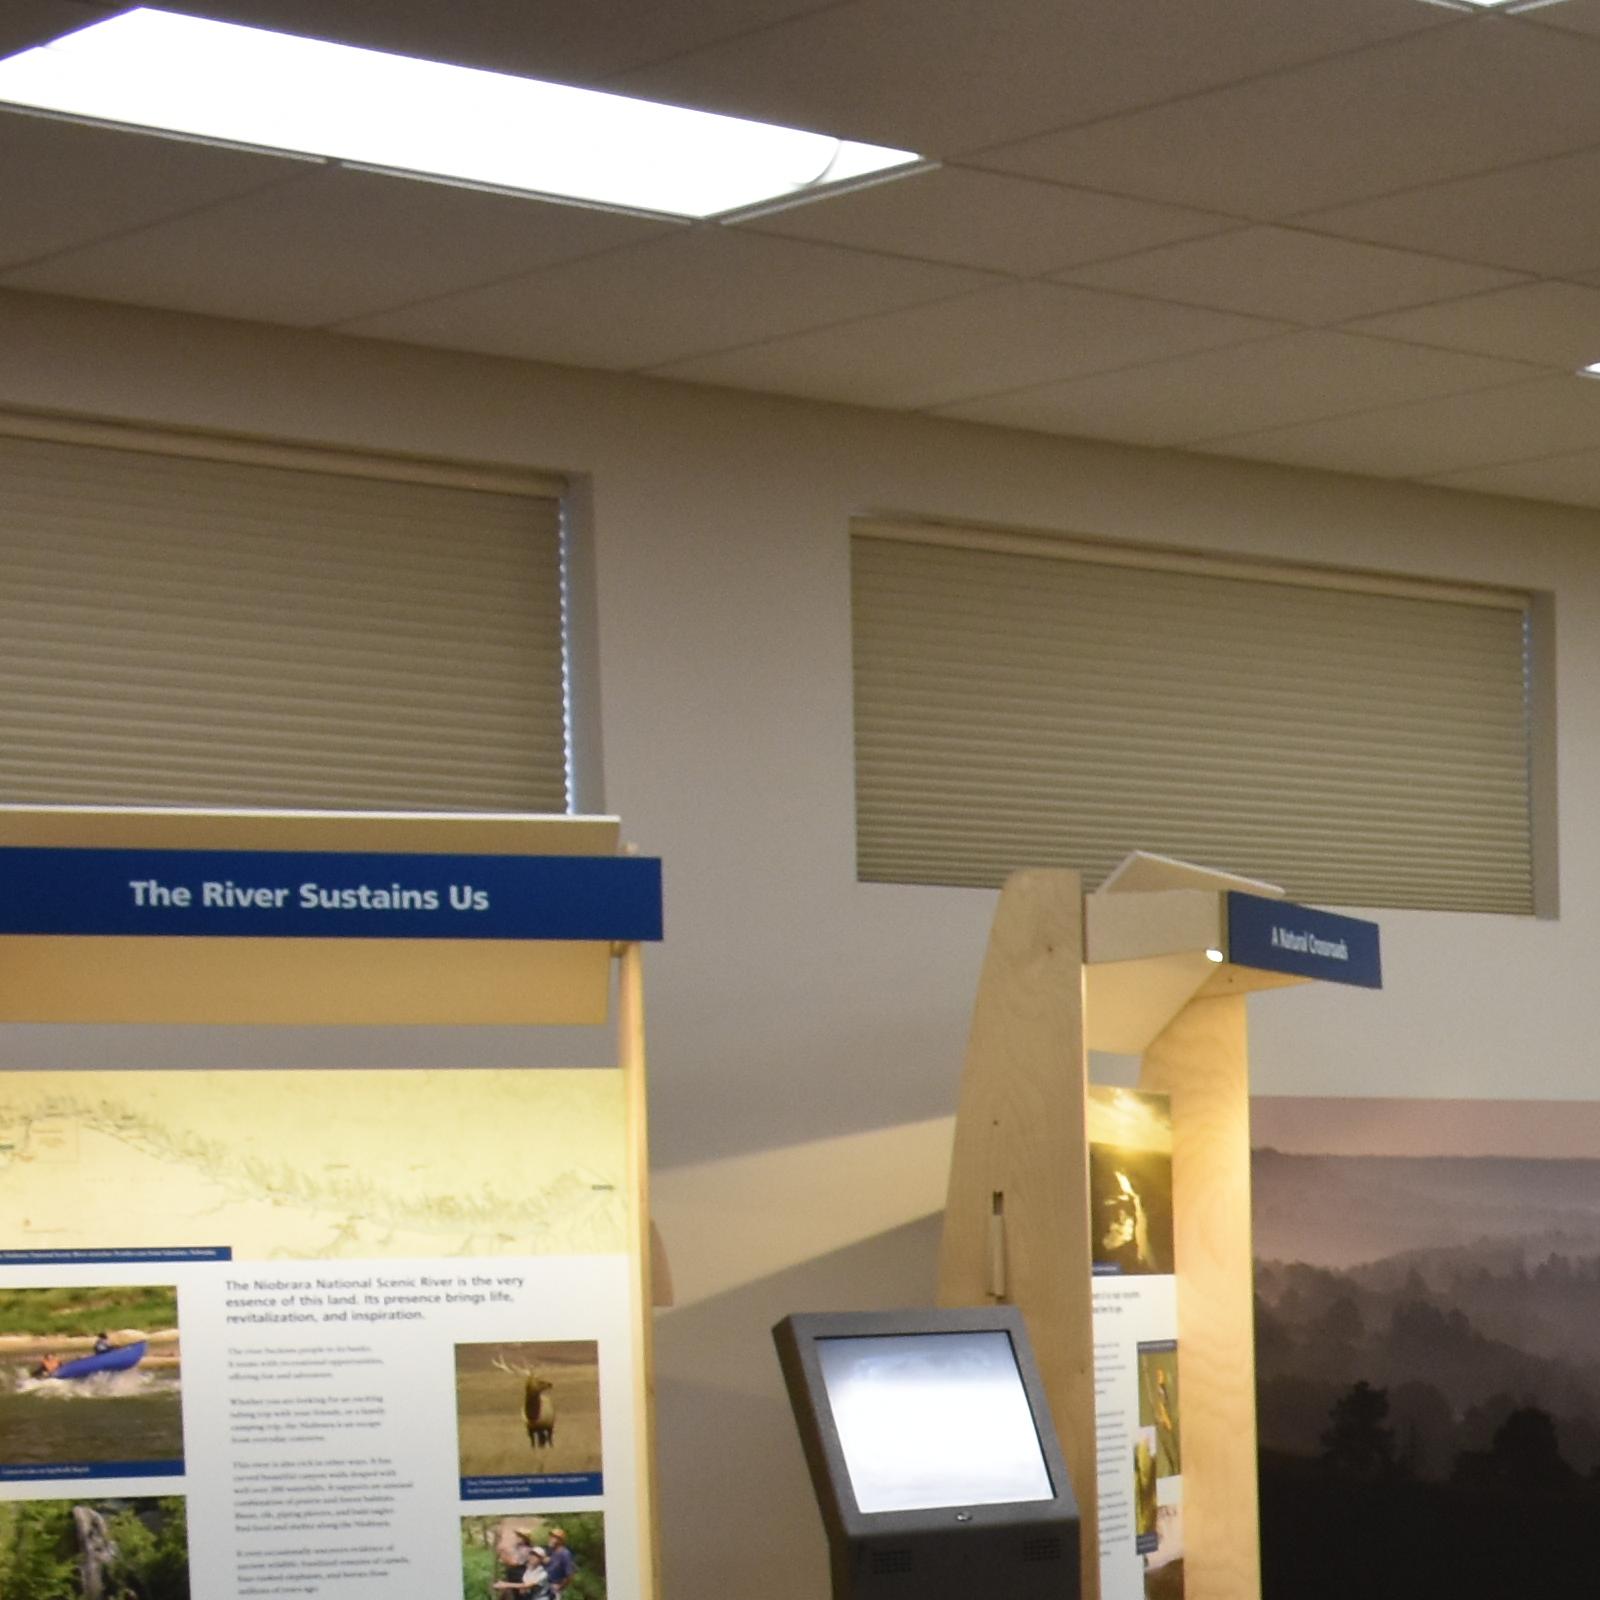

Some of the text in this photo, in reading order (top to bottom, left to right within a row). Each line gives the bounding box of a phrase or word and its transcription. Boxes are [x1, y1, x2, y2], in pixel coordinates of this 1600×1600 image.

[129, 880, 489, 911] The River Sustains Us
[1272, 926, 1279, 946] A
[1279, 927, 1308, 954] Natural
[225, 1275, 524, 1291] The Niobrara National Scenic River is the very
[225, 1290, 515, 1308] essence of this land. Its presence brings life,
[226, 1309, 425, 1325] revitalization, and inspiration.
